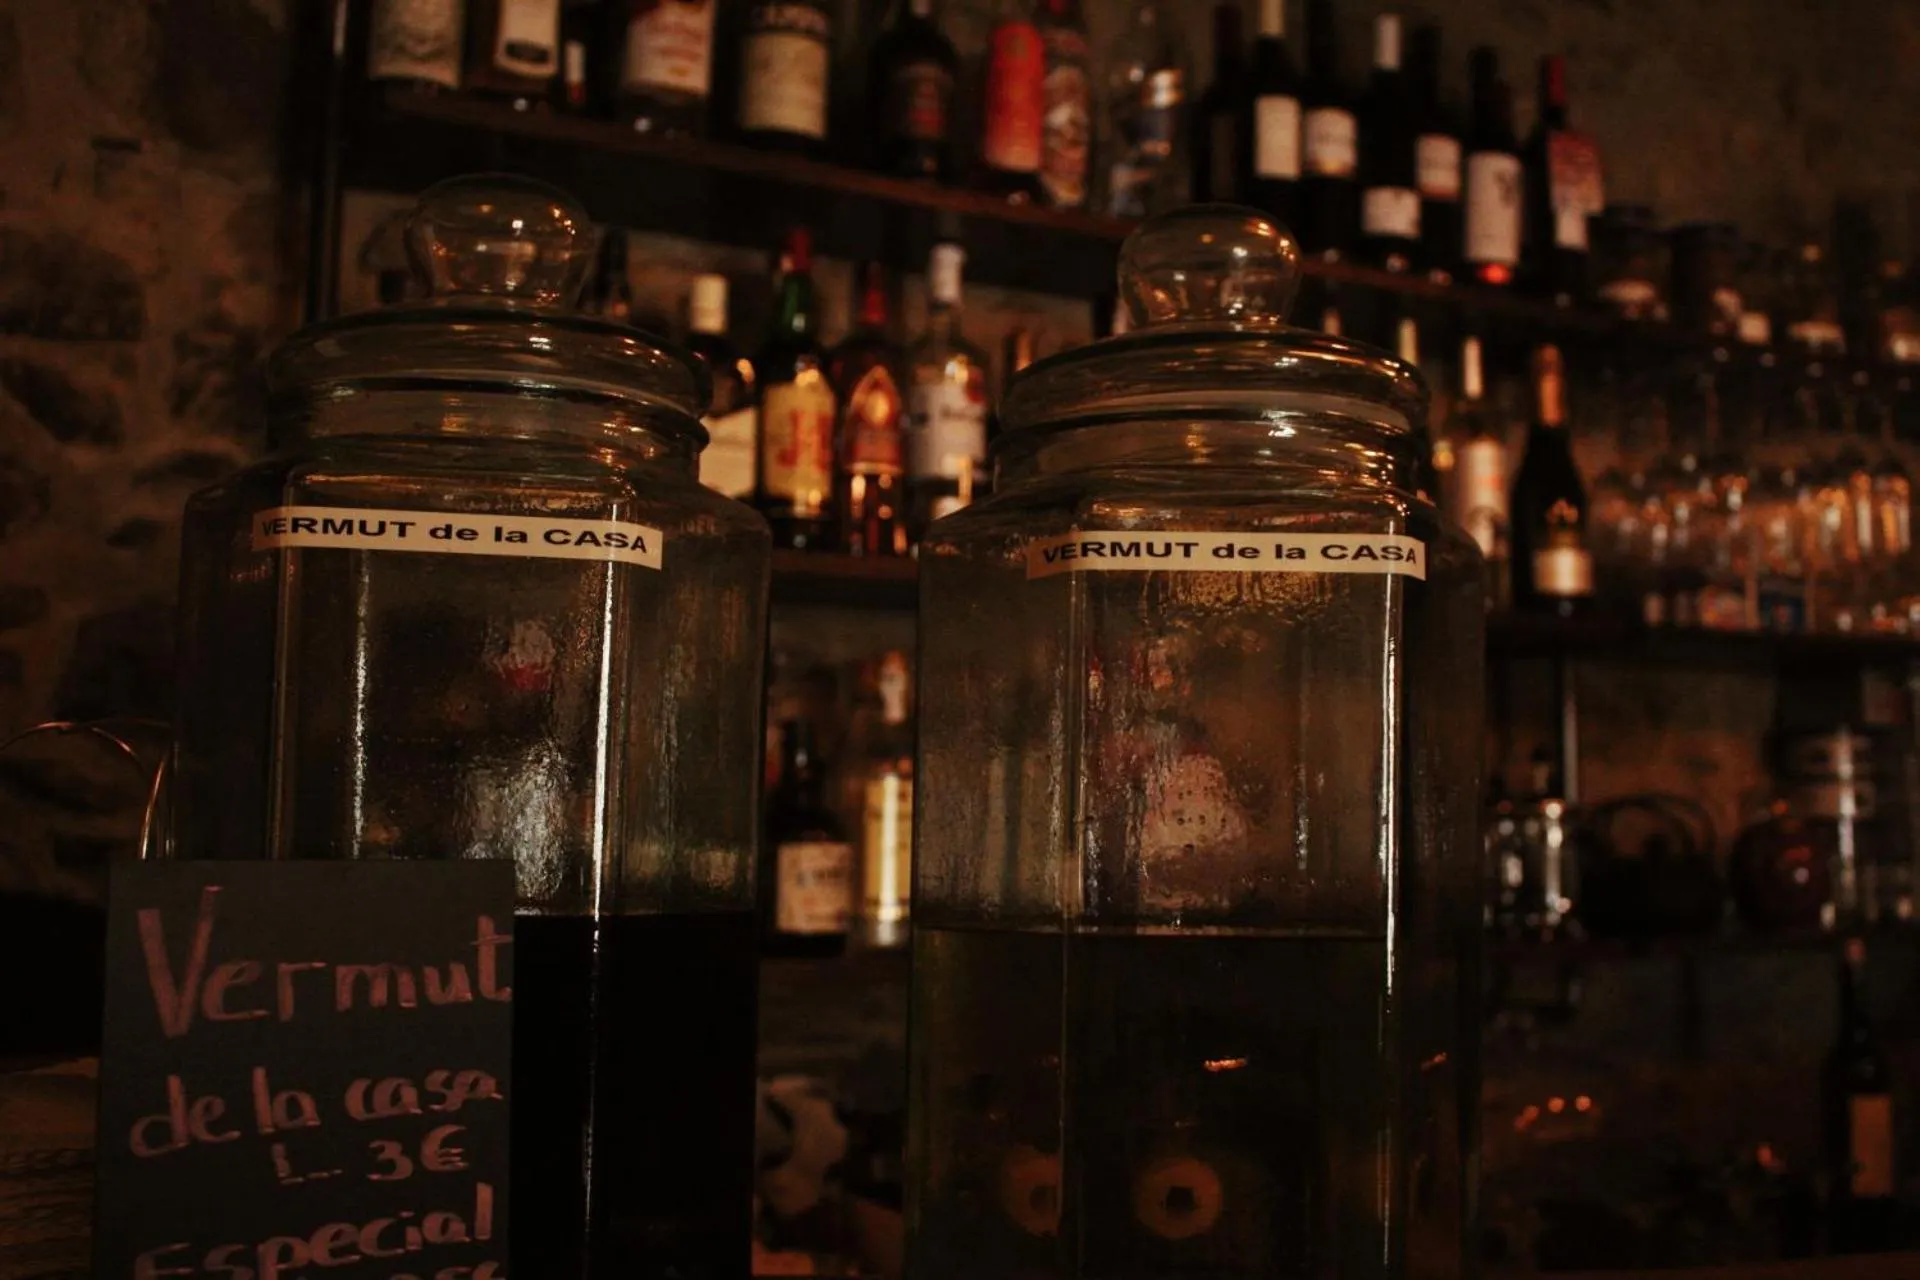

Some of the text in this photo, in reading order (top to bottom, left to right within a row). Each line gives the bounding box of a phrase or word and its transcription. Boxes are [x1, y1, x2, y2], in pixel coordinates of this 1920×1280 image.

[262, 517, 648, 554] VERMUT de la CASA
[1042, 541, 1417, 565] VERMUT de la CASA
[136, 885, 514, 1039] Vermut
[129, 1065, 504, 1159] de la casa
[134, 1181, 495, 1280] Especial
